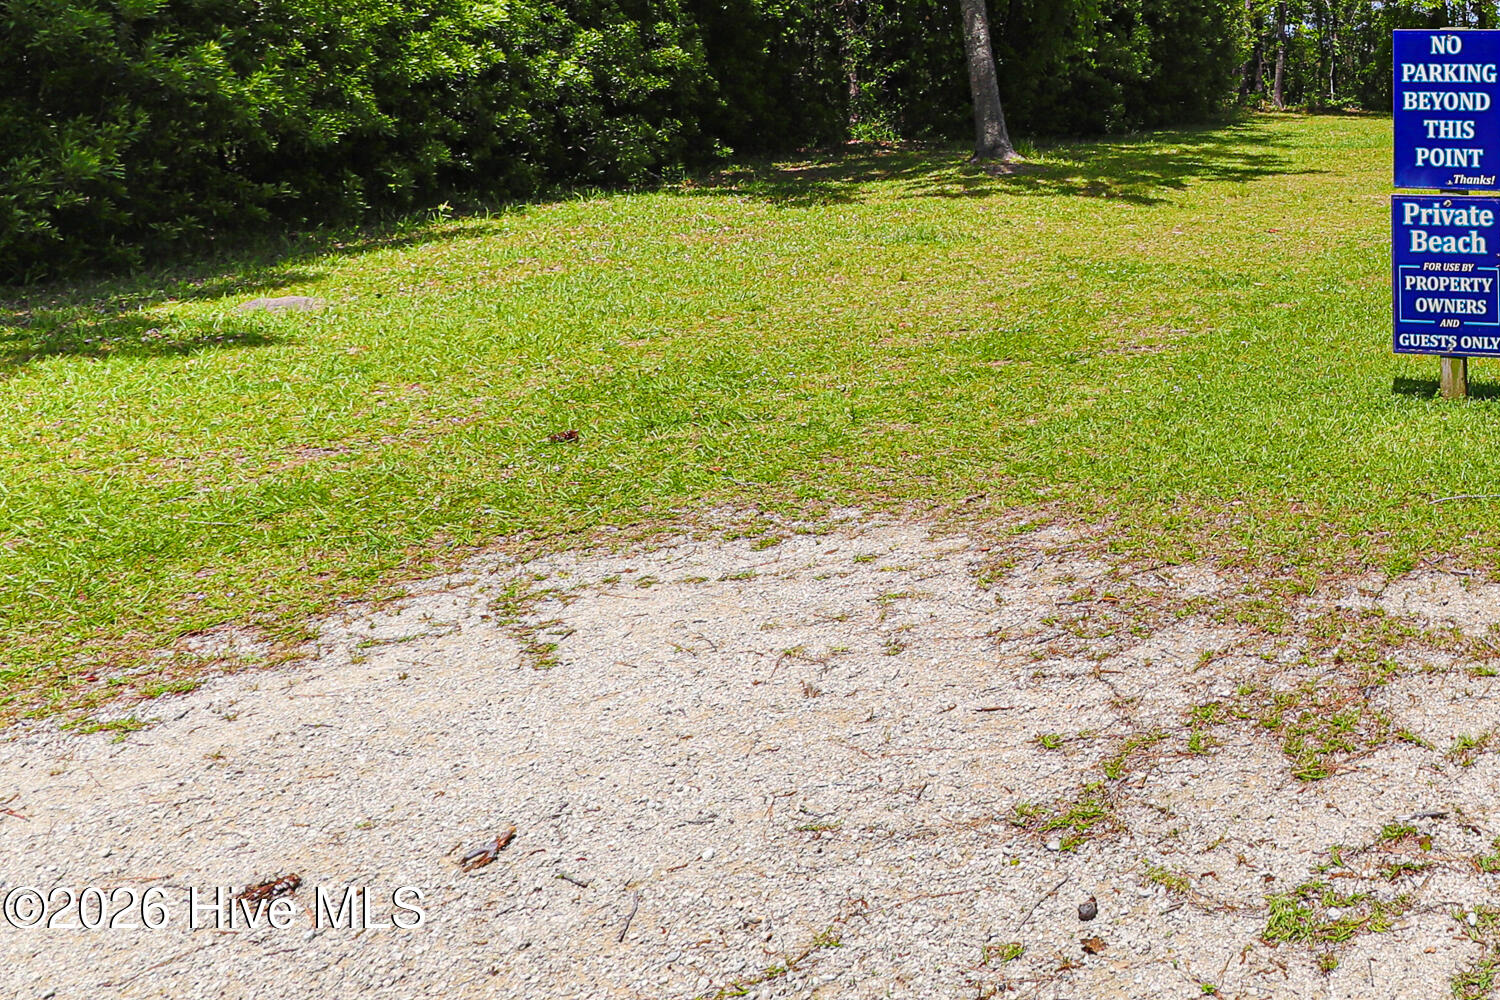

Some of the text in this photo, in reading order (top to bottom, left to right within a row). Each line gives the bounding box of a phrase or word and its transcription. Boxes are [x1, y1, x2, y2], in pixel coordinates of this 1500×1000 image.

[1430, 35, 1462, 54] NO
[1401, 64, 1497, 83] PARKING
[1402, 91, 1491, 111] BEYOND
[1423, 120, 1475, 139] THIS
[1415, 147, 1483, 167] POINT
[1402, 202, 1494, 227] Private
[1409, 229, 1488, 254] Beach
[1423, 262, 1474, 272] FOR USE BY
[1404, 275, 1493, 293] PROPERTY
[1415, 297, 1487, 315] OWNERS
[1440, 319, 1460, 328] AND
[1399, 333, 1500, 350] GUESTS ONLY
